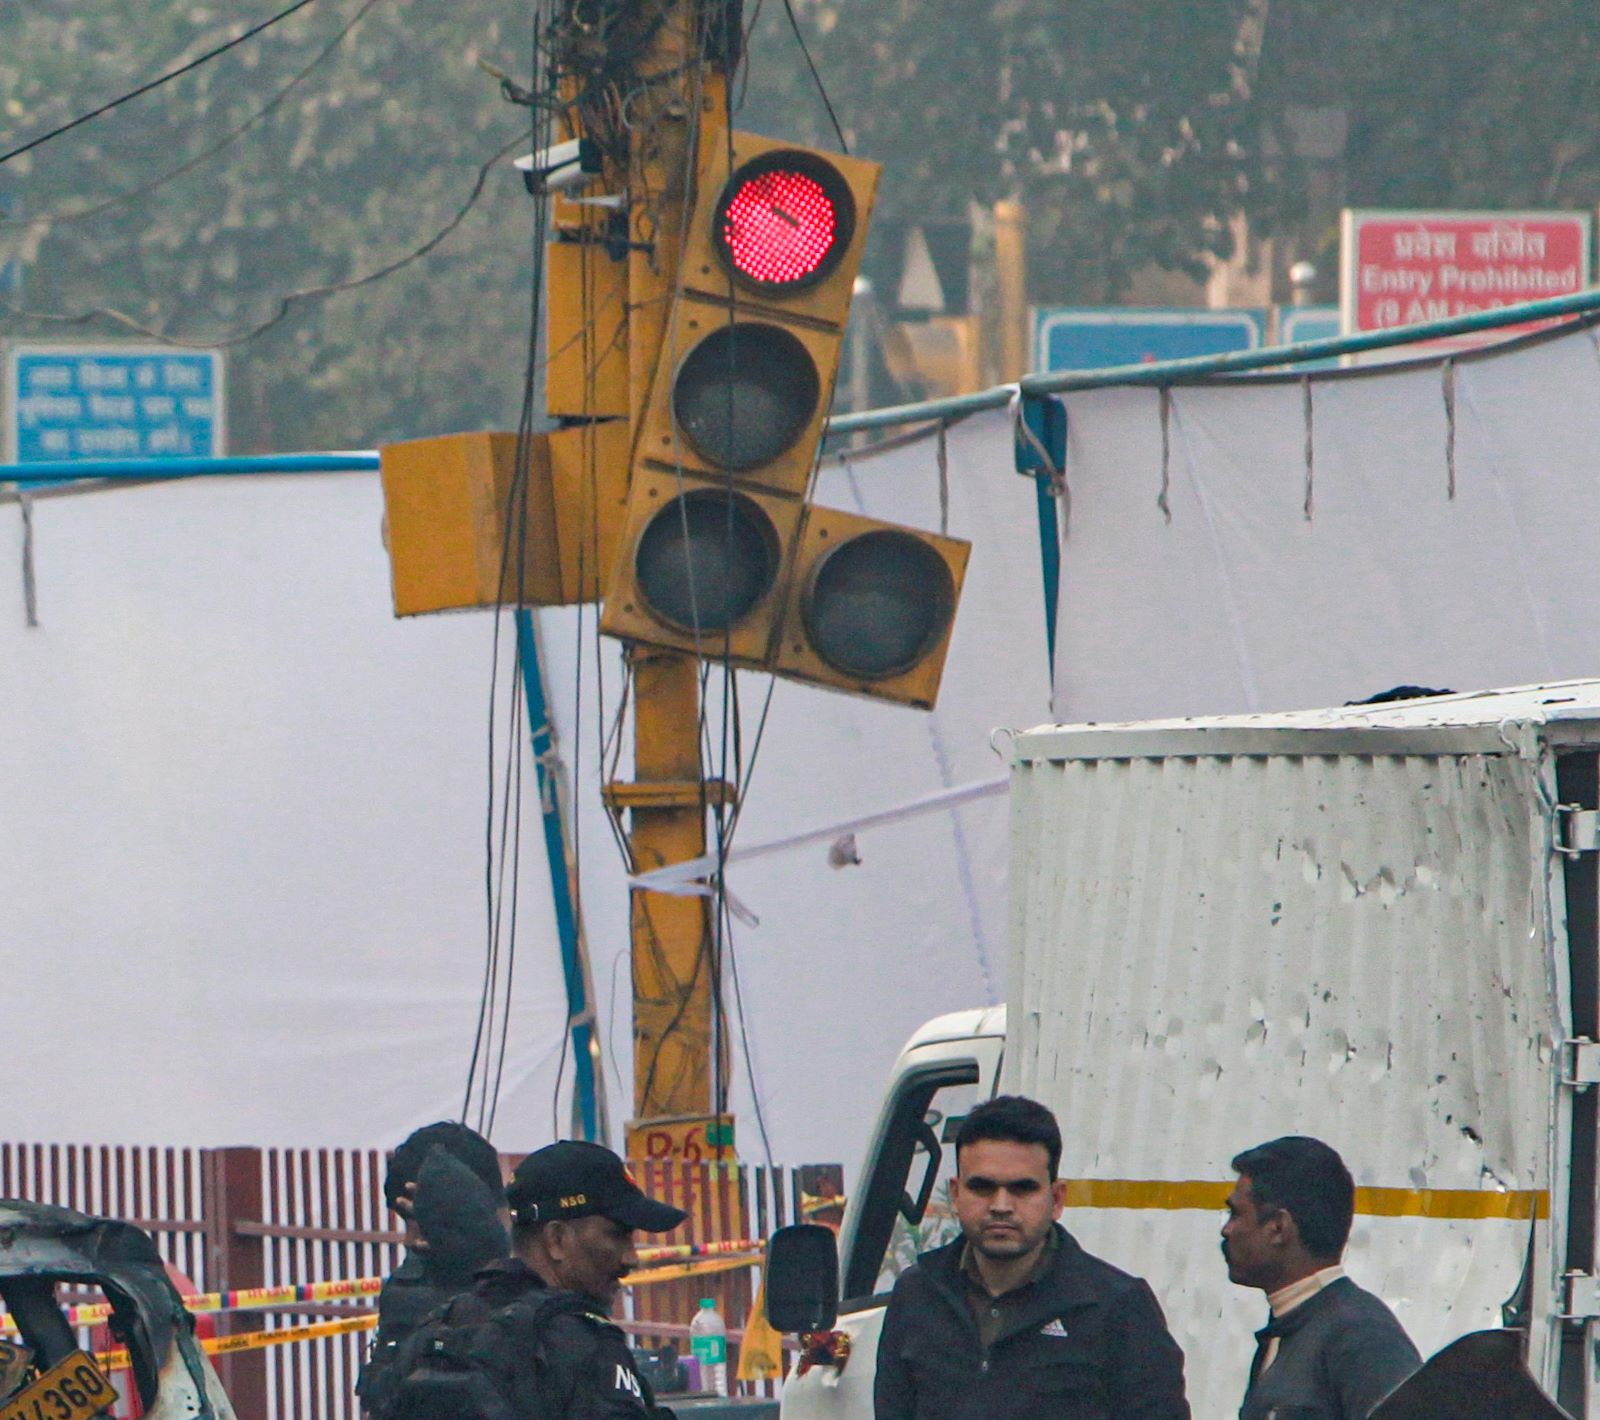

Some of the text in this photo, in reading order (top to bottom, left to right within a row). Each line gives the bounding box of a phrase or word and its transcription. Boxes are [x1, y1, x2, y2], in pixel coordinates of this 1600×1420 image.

[1362, 264, 1577, 296] Entry Prohibited
[560, 1194, 587, 1208] NSG
